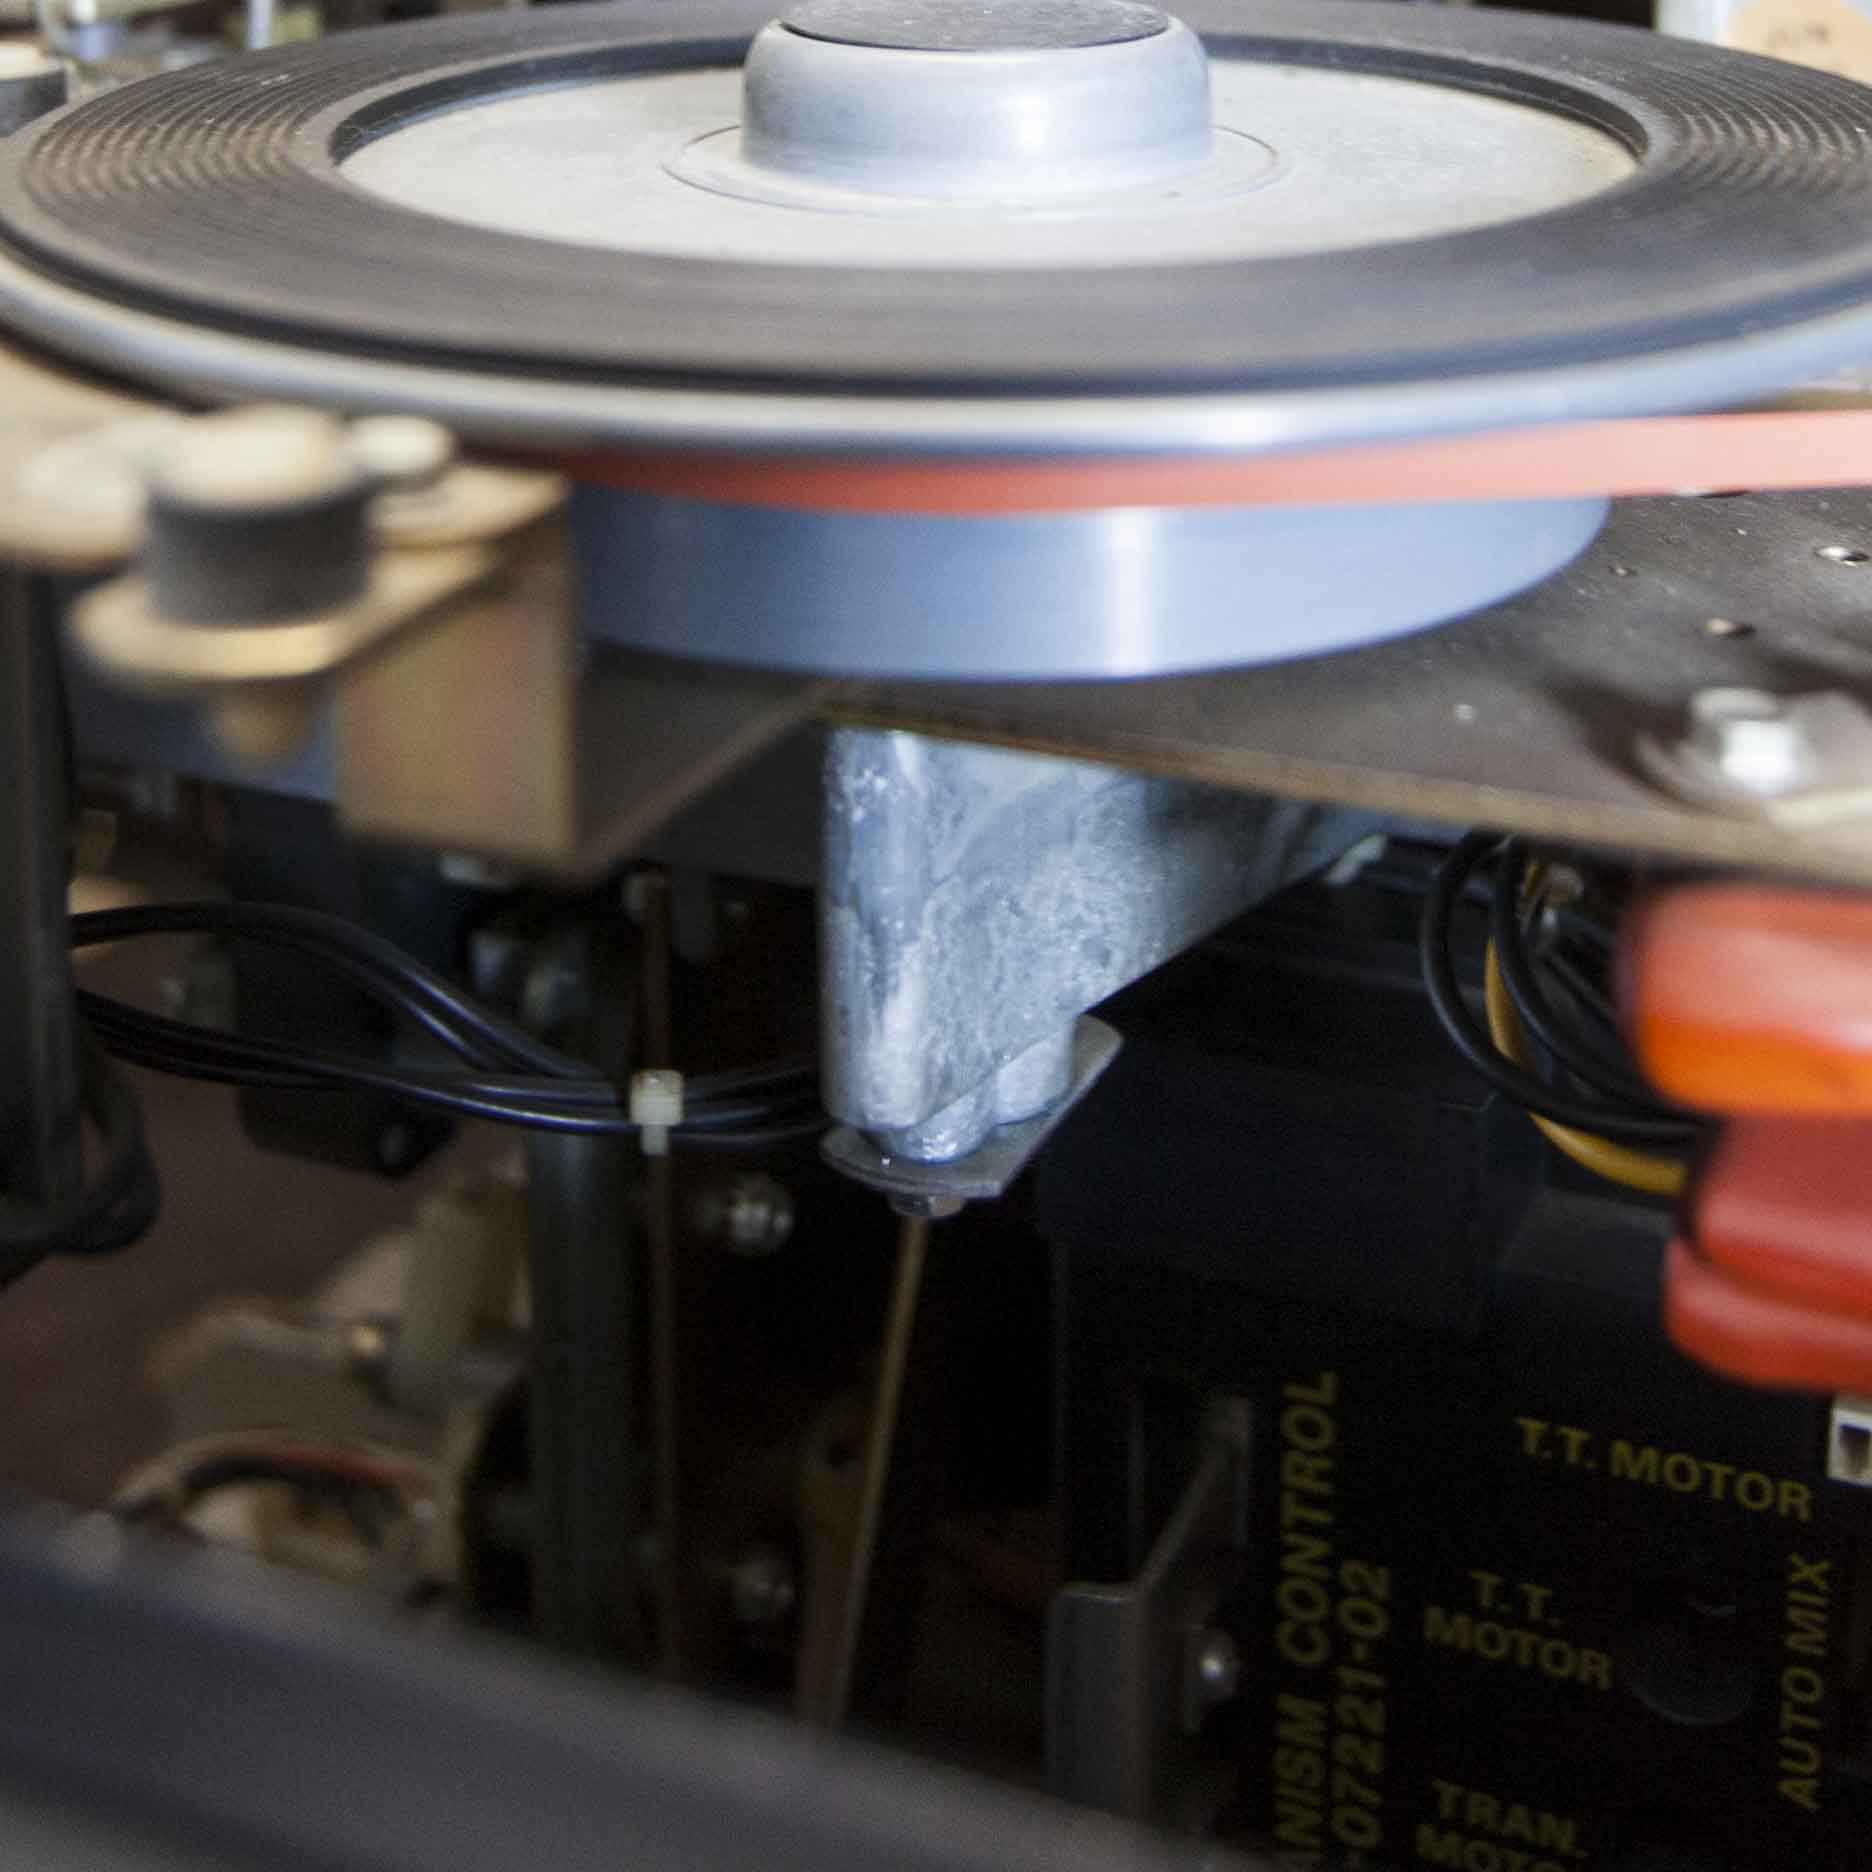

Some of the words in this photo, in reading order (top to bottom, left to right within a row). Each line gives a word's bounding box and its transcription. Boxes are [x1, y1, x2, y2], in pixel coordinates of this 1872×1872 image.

[1275, 1369, 1339, 1667] CONTROL
[1513, 1414, 1601, 1470] T.T.
[1609, 1438, 1817, 1523] MOTOR
[1422, 1603, 1617, 1693] MOTOR
[1781, 1551, 1835, 1656] MIX
[1774, 1666, 1826, 1811] AUTO
[1431, 1778, 1589, 1856] TRAN.
